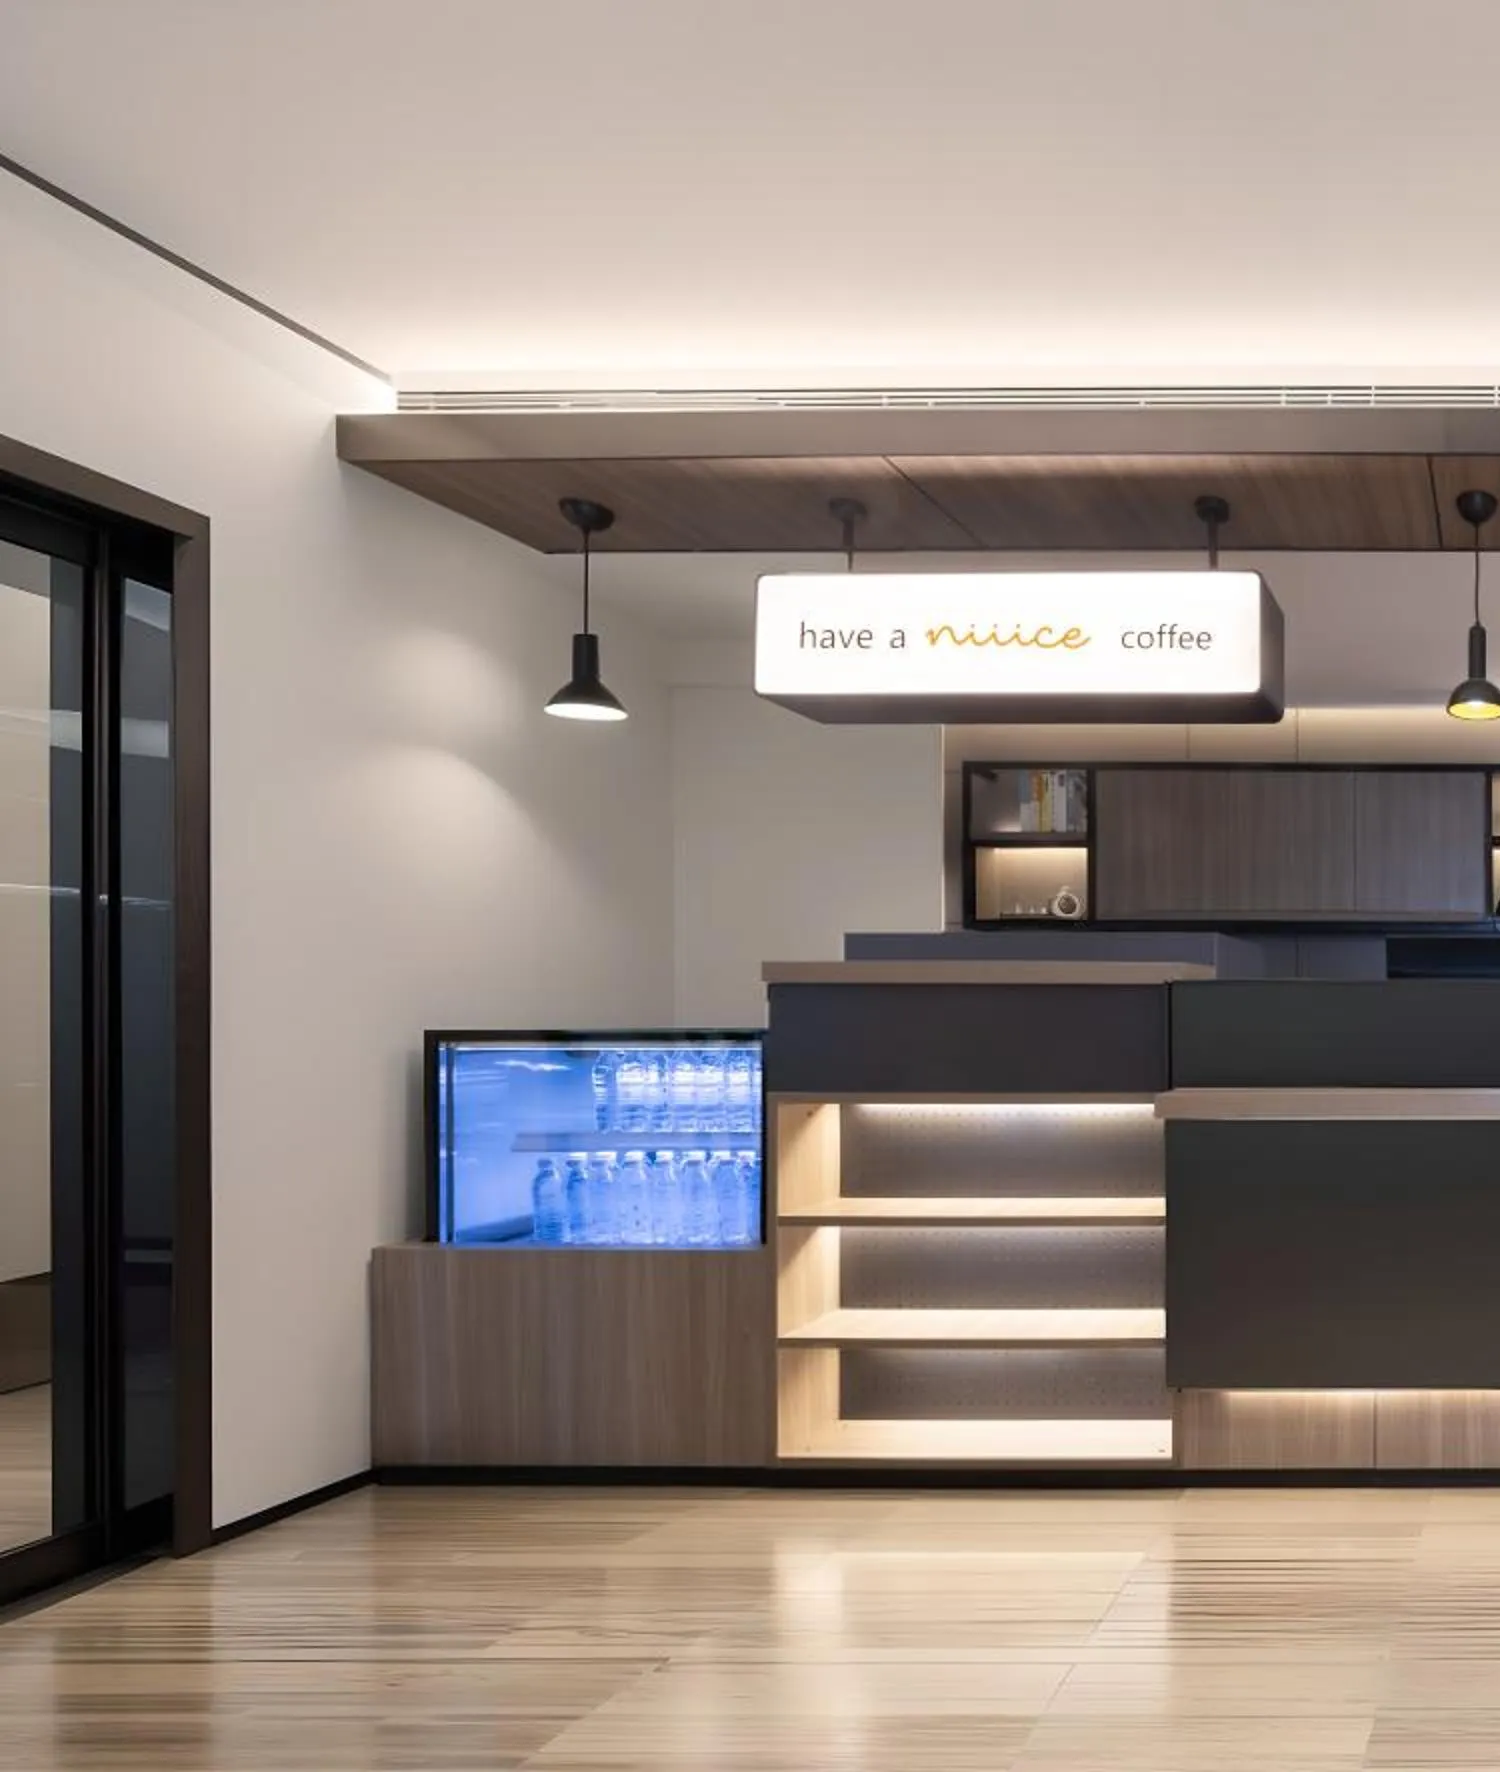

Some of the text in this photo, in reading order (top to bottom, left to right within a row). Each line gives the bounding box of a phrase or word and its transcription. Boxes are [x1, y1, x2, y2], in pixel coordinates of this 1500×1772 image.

[799, 621, 1212, 651] have a niiice coffee
